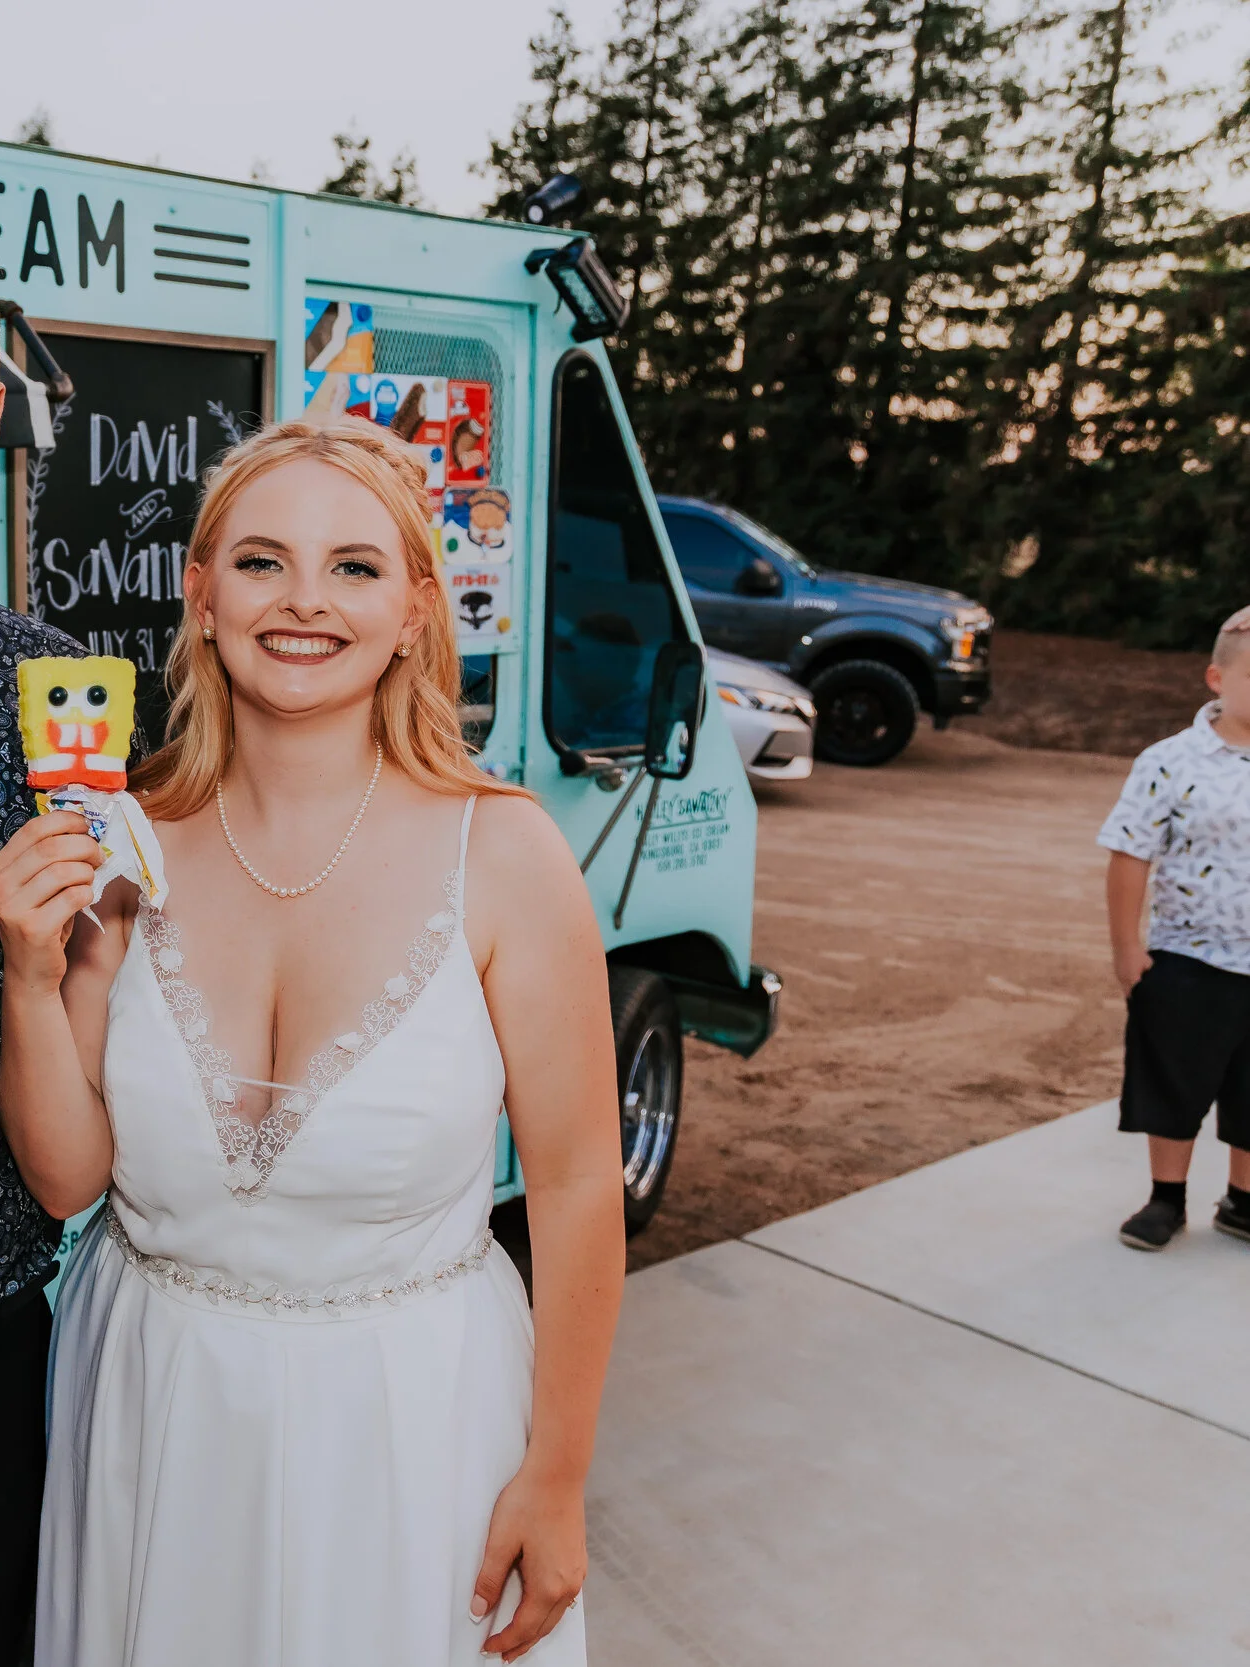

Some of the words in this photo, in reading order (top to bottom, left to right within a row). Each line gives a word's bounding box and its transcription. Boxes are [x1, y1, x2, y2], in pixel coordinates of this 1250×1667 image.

[90, 413, 198, 486] David
[132, 498, 158, 529] AND
[43, 538, 185, 611] Savann
